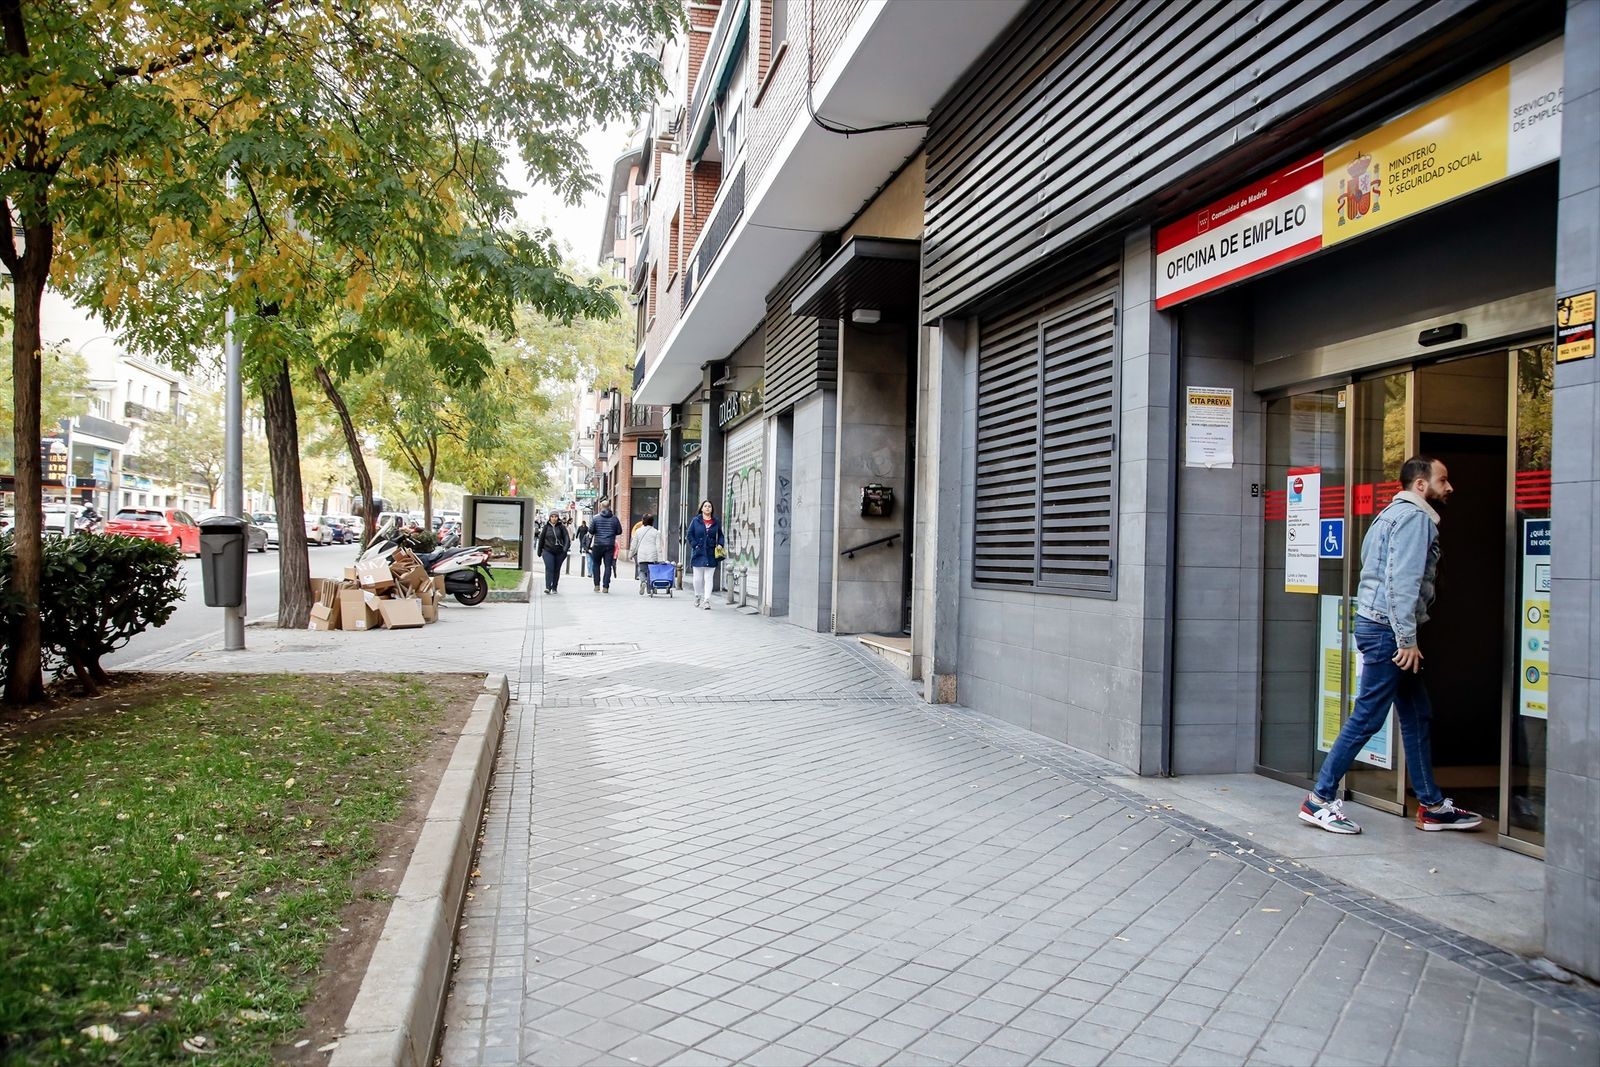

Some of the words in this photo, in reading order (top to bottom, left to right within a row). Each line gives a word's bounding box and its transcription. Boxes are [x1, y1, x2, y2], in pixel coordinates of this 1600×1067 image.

[1513, 92, 1555, 118] SERVICIO
[1513, 119, 1525, 133] DE
[1388, 142, 1437, 172] MINISTERIO
[1388, 169, 1400, 185] DE
[1401, 157, 1435, 179] EMPLEO
[1388, 186, 1395, 197] Y
[1396, 166, 1446, 195] SEGURIDAD
[1447, 151, 1482, 173] SOCIAL
[1211, 203, 1240, 221] Comunidad
[1240, 198, 1248, 208] de
[1248, 188, 1268, 204] Madrid
[1167, 244, 1217, 280] OFICINA
[1220, 233, 1238, 258] DE
[1243, 204, 1307, 248] EMPLEO
[1530, 529, 1544, 538] ¿QUÉ
